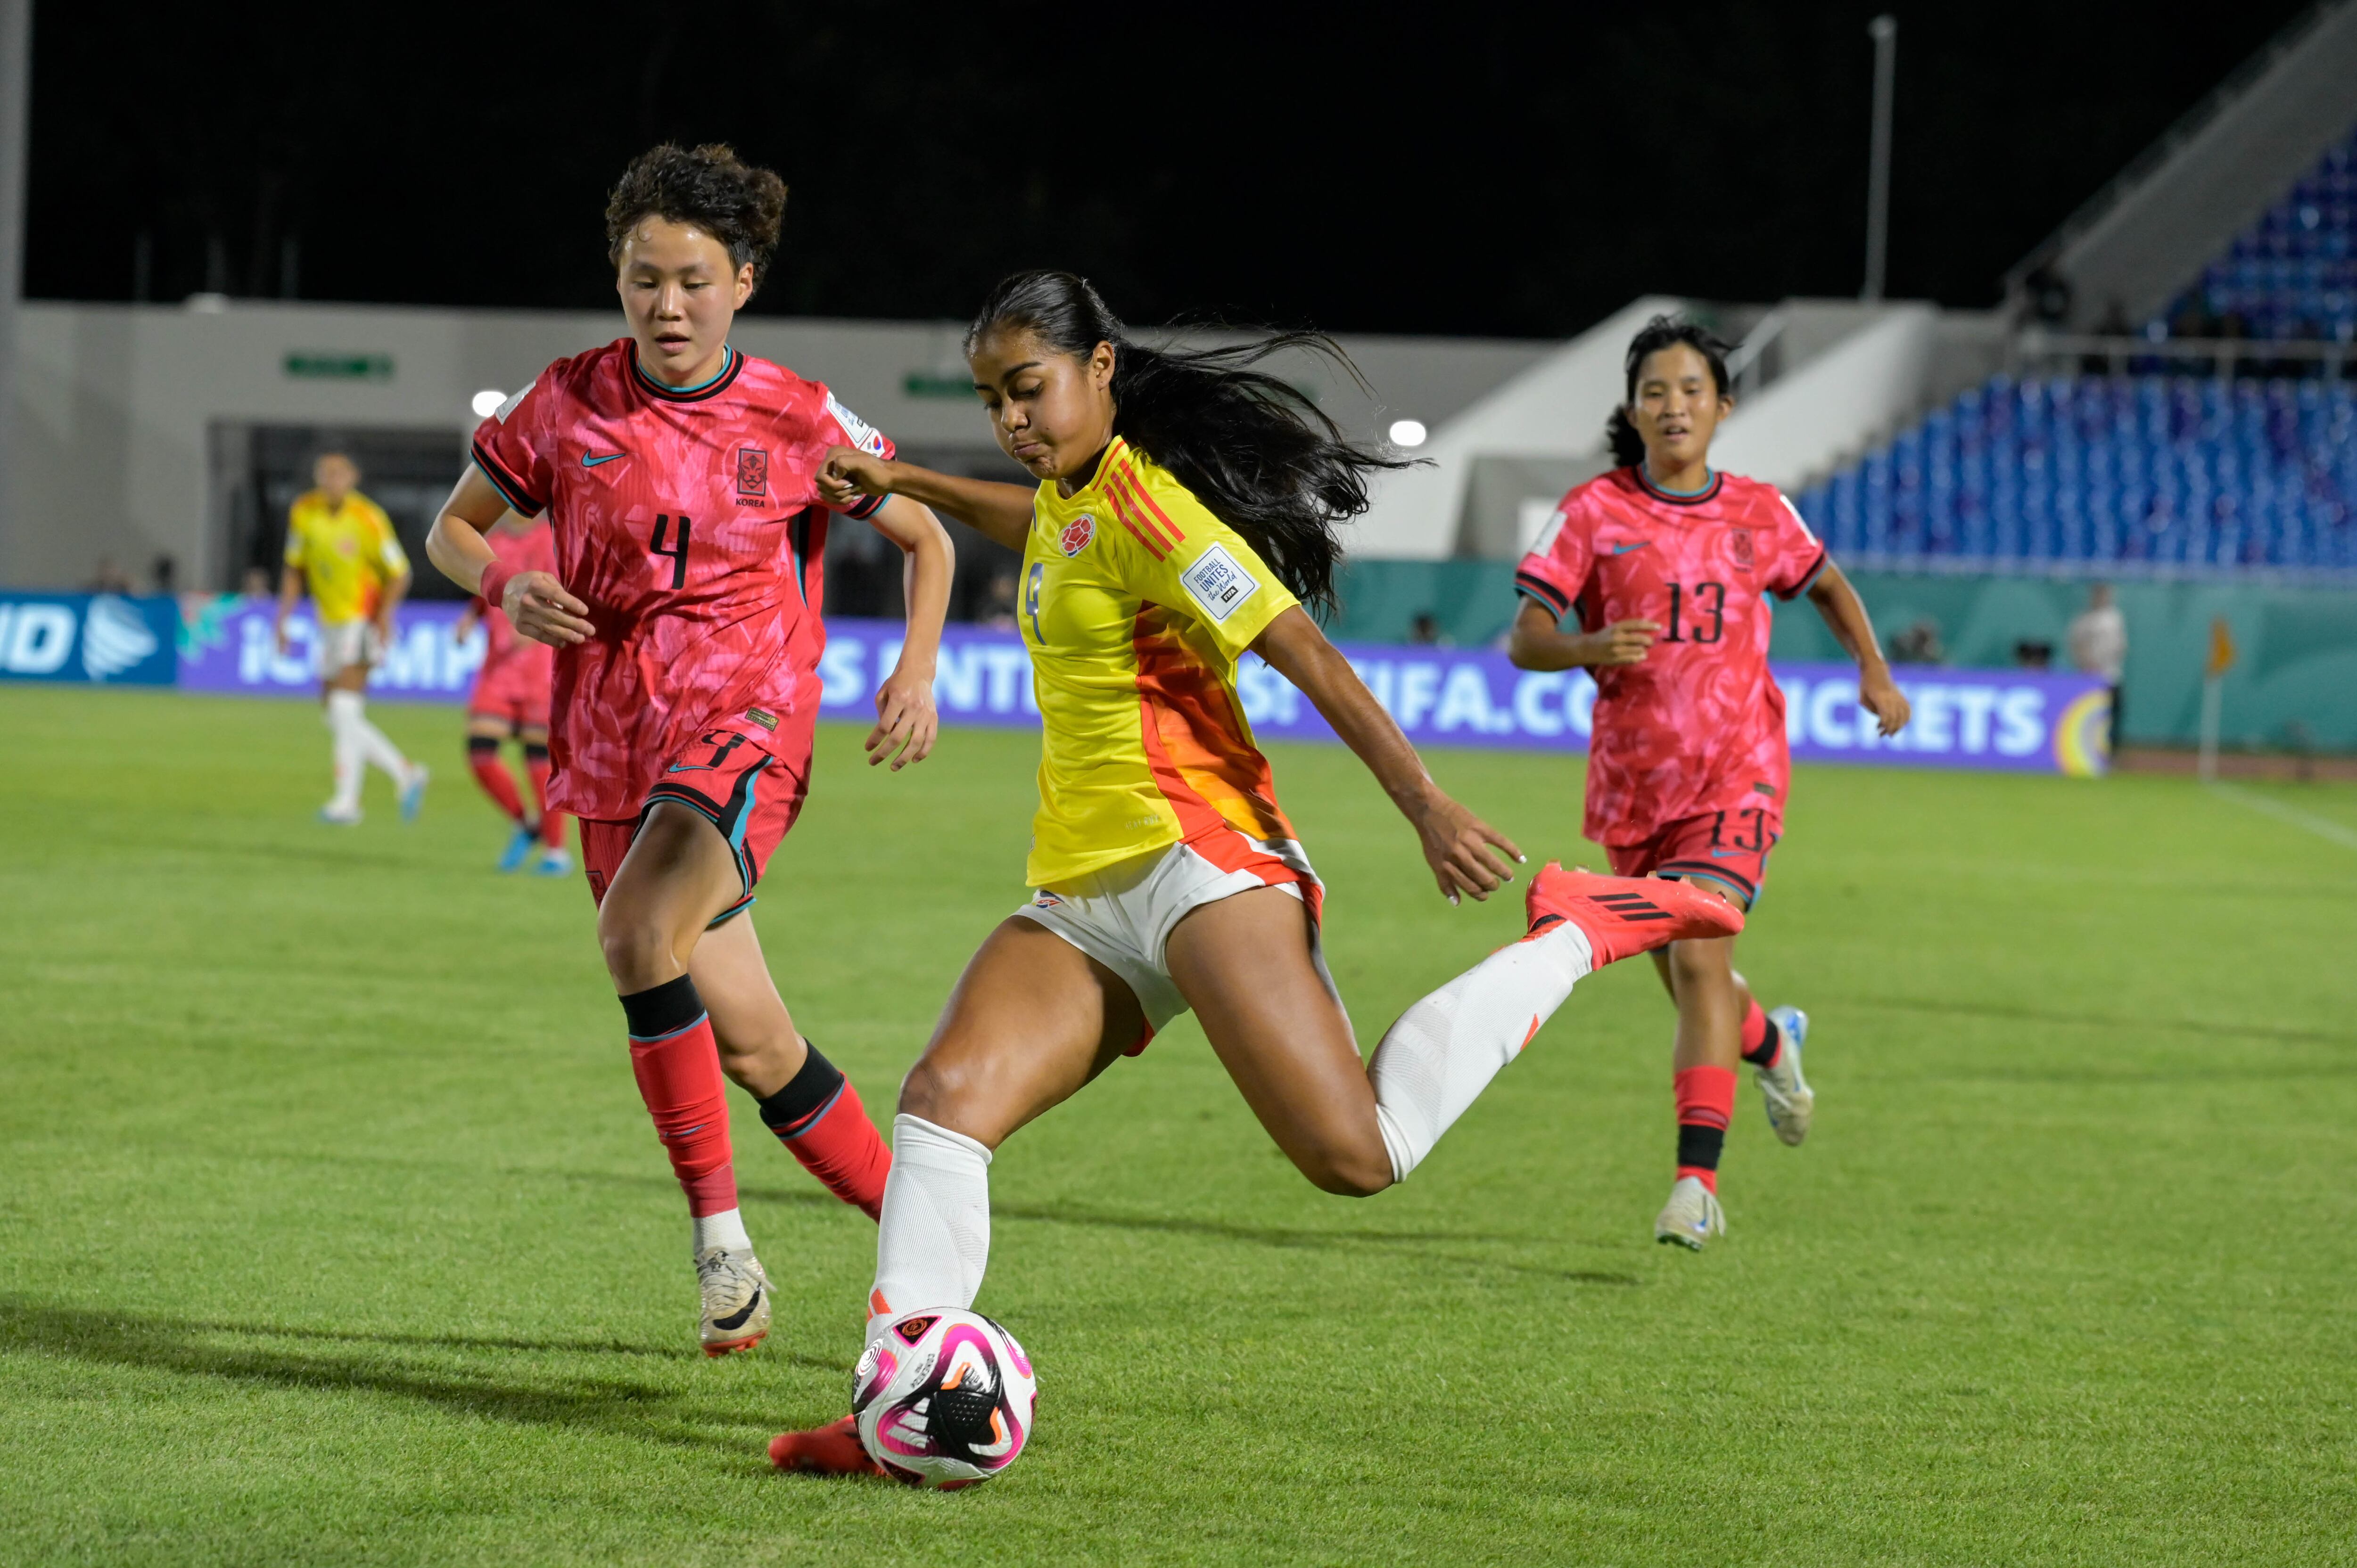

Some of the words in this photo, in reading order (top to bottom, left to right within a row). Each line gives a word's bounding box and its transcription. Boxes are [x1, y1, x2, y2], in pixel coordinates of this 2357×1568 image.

[736, 498, 765, 508] KOREA
[650, 513, 691, 590] 4
[1194, 558, 1221, 584] FOOTBALL
[1199, 564, 1228, 592] UNITES
[1207, 590, 1220, 601] the
[1216, 571, 1237, 592] World
[1025, 562, 1047, 646] 9
[1223, 588, 1236, 601] FIFA
[1662, 582, 1726, 643] 13
[701, 730, 747, 768] 4
[1705, 808, 1765, 852] 13
